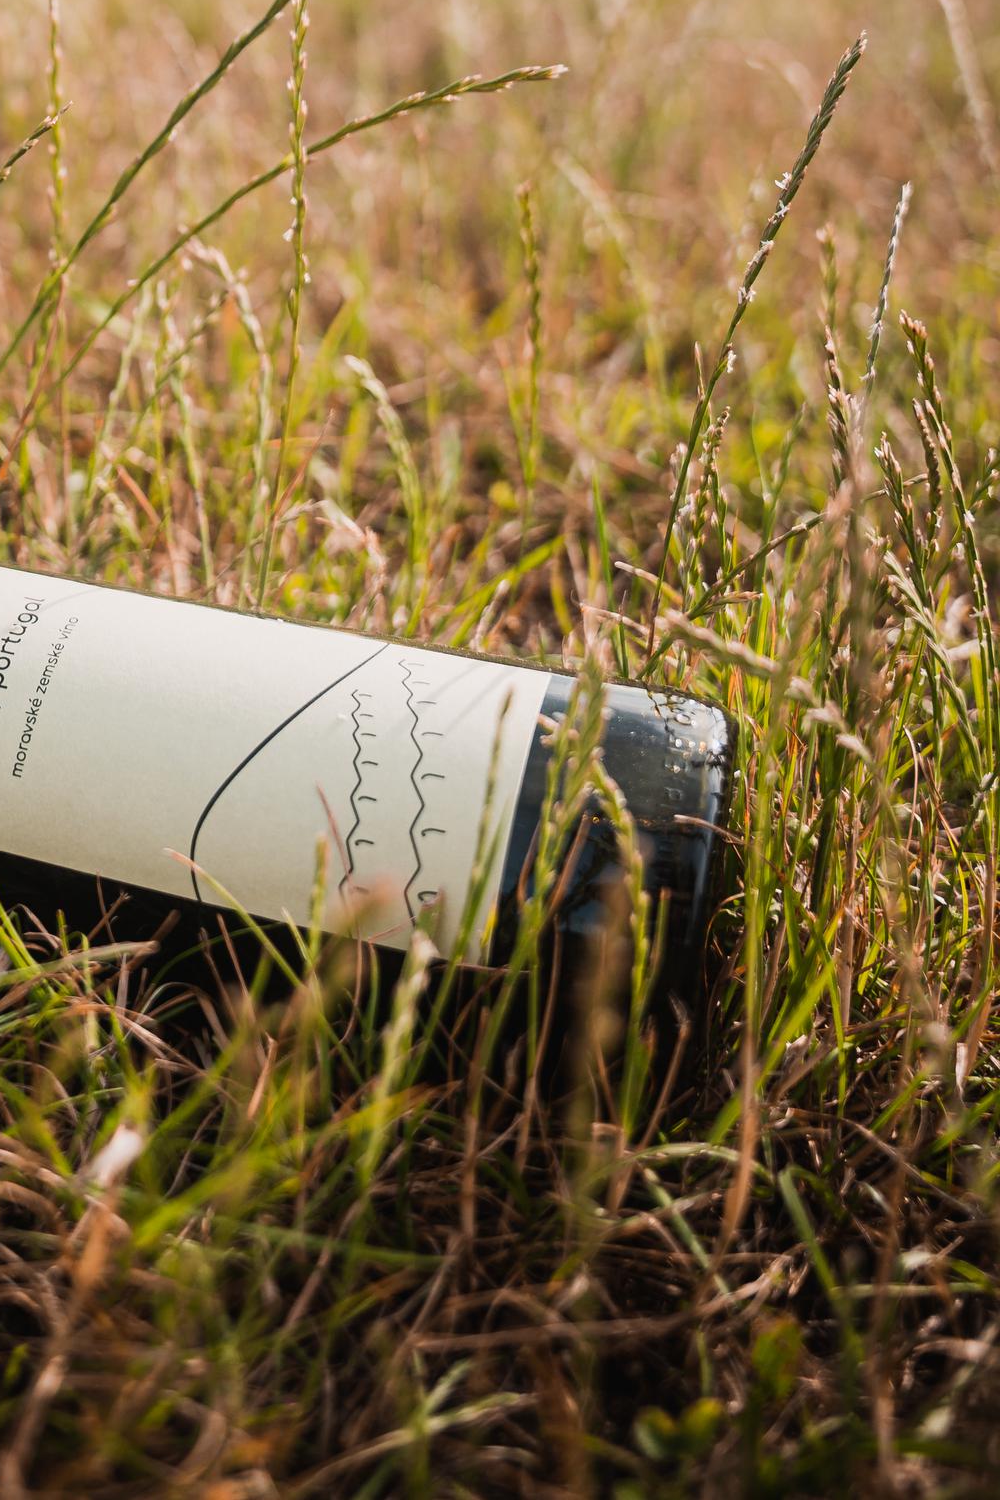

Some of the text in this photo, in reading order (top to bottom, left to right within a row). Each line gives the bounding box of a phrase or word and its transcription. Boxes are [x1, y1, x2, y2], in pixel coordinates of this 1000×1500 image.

[12, 615, 80, 779] moravské zemské víno
